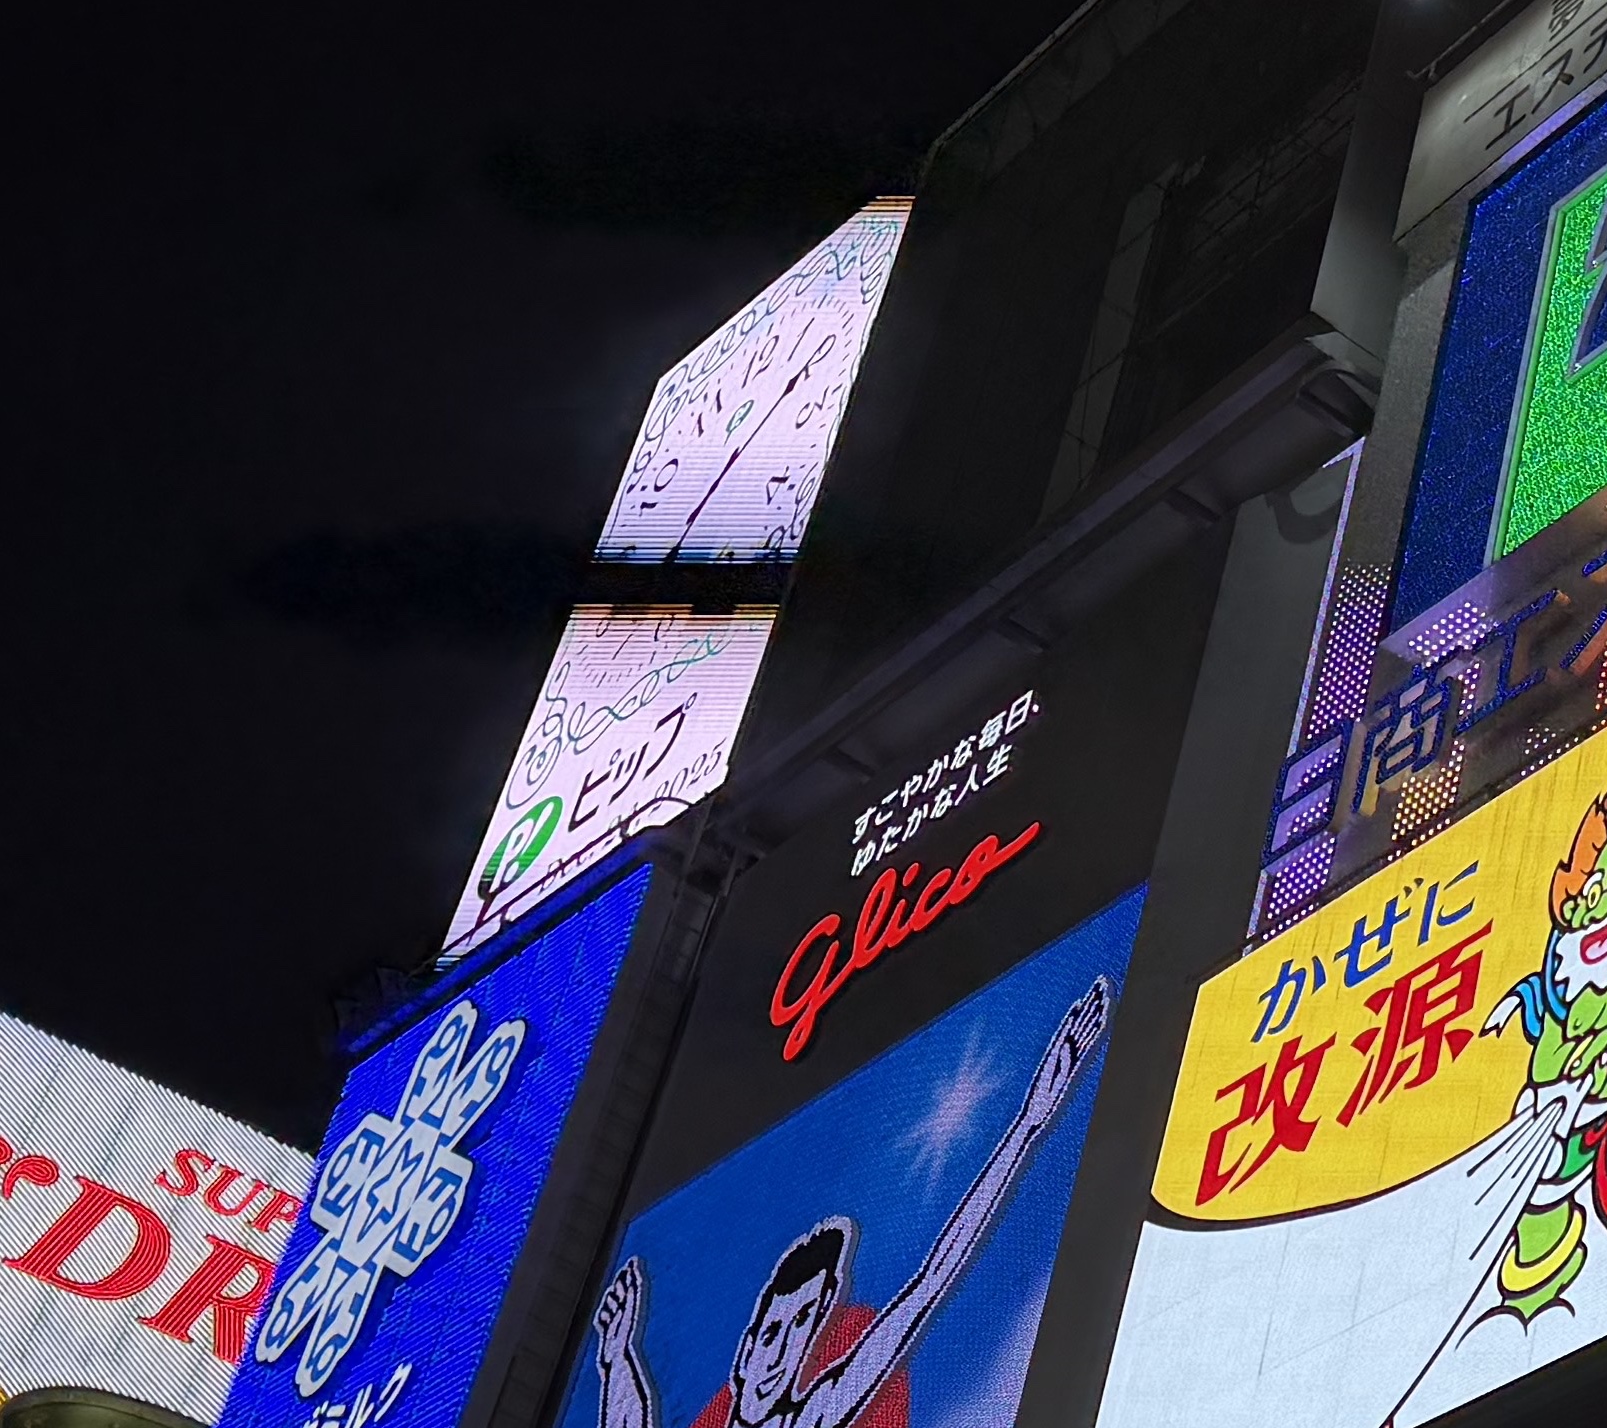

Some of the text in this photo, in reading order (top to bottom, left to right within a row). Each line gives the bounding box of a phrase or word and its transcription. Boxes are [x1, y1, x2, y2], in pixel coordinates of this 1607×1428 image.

[568, 692, 698, 833] ピップ
[850, 743, 1014, 876] ゆたかな人生
[768, 821, 1043, 1062] Glico
[1251, 860, 1480, 1043] かぜに
[1194, 918, 1494, 1206] 改源
